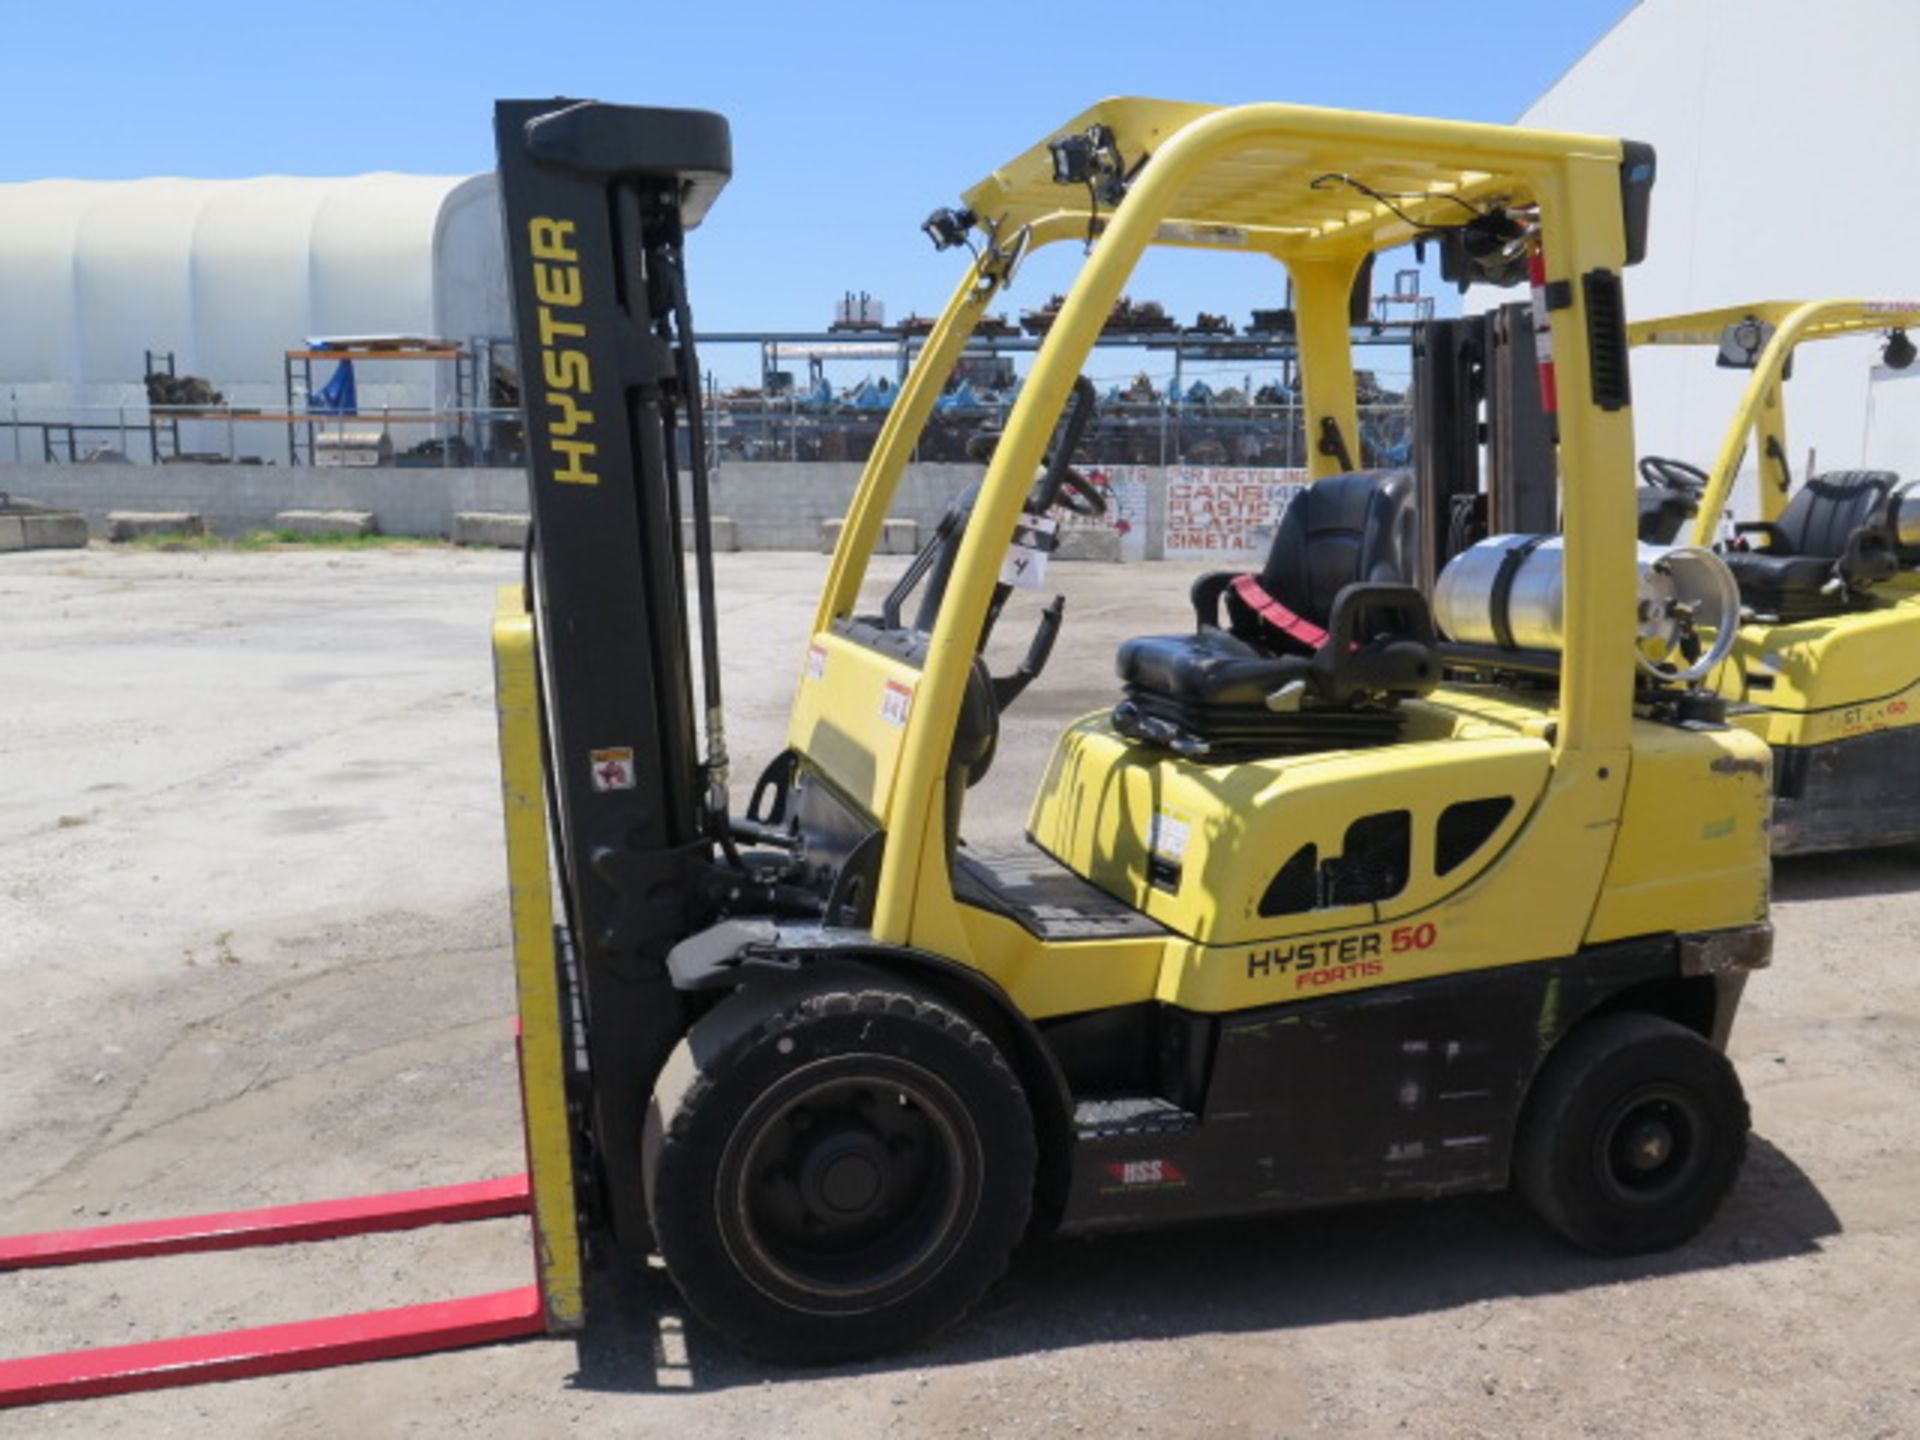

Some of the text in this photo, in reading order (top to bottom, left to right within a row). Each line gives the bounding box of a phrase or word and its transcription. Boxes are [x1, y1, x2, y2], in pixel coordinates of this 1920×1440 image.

[528, 216, 599, 485] HYSTER
[1247, 922, 1437, 978] HYSTER 50
[1295, 960, 1383, 990] FORTIS
